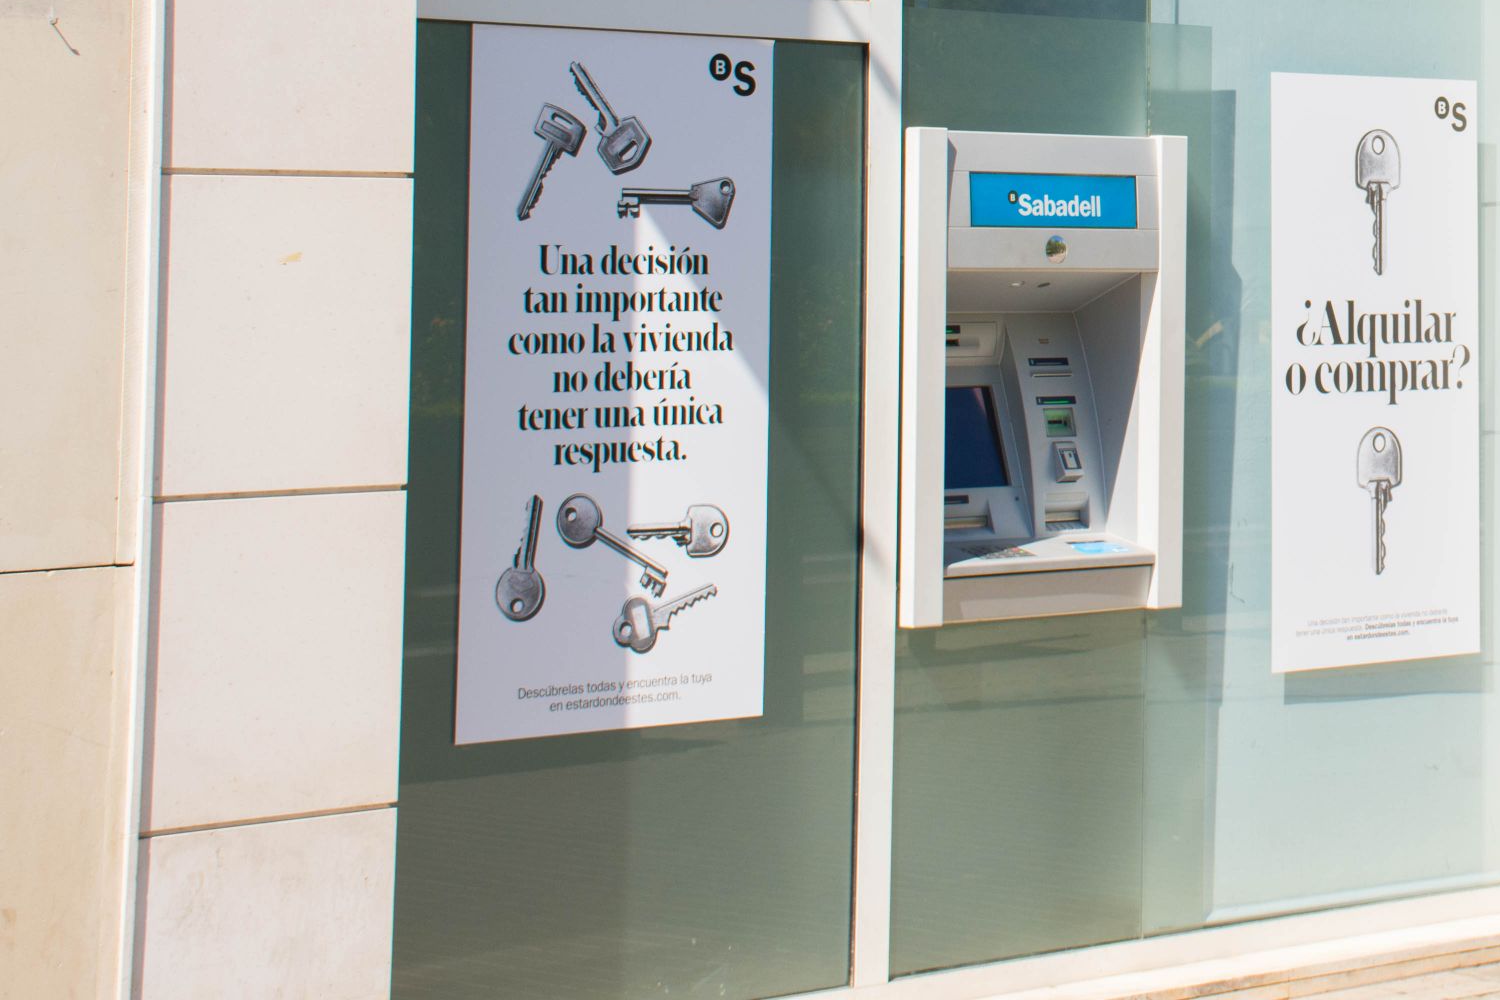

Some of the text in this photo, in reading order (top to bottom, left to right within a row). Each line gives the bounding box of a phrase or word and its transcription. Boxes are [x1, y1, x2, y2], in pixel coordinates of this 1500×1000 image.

[733, 61, 756, 97] S
[1451, 102, 1468, 133] S
[1018, 193, 1101, 217] Sabadell
[540, 245, 709, 275] Una decisión
[523, 283, 723, 321] tan importante
[508, 322, 734, 355] como la vivienda
[1296, 299, 1456, 358] ¿Alquilar
[552, 361, 692, 393] no debería
[1285, 344, 1470, 405] o comprar?
[517, 396, 724, 431] tener una única
[553, 436, 687, 473] respuesta.
[586, 680, 616, 693] todas
[550, 701, 563, 712] en
